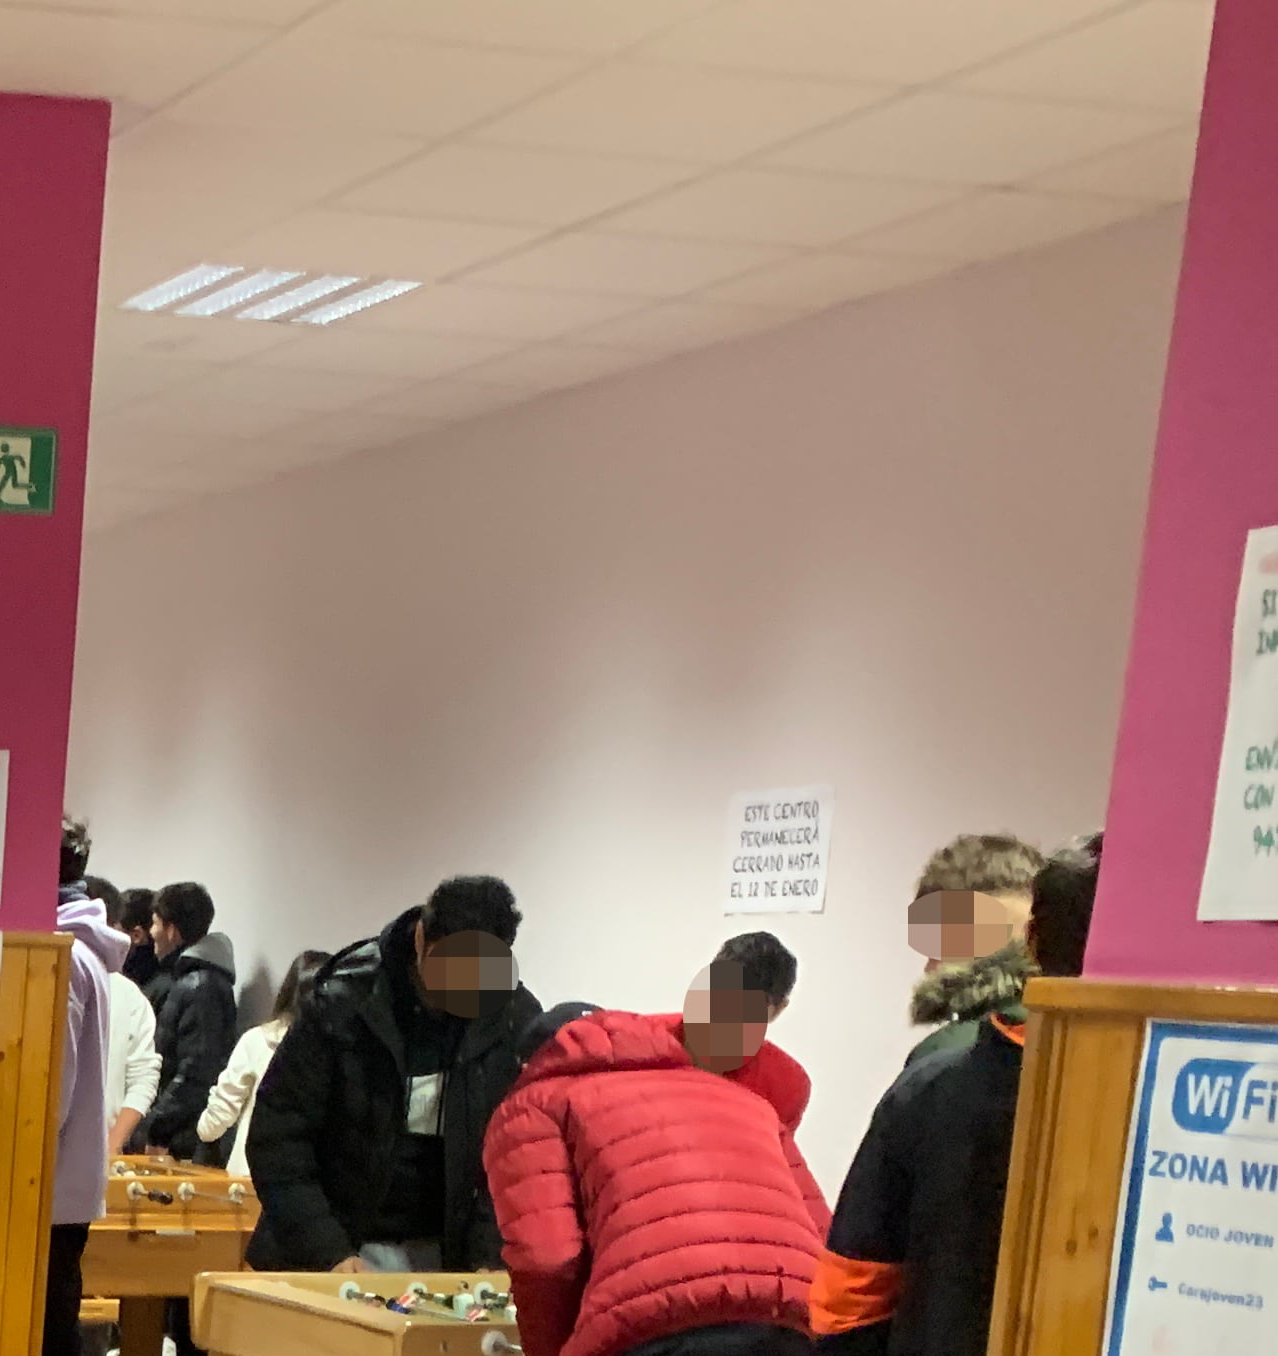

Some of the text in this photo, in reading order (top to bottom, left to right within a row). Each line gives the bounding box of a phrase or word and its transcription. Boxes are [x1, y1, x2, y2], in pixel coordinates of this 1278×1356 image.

[744, 800, 820, 823] ESTE CENTRO
[732, 851, 820, 874] CERRADO HASTA
[731, 880, 743, 898] EL
[764, 880, 778, 898] DE
[781, 878, 819, 898] ENERO
[1148, 1149, 1229, 1186] ZONA
[1185, 1223, 1275, 1249] OCIO JOVEN
